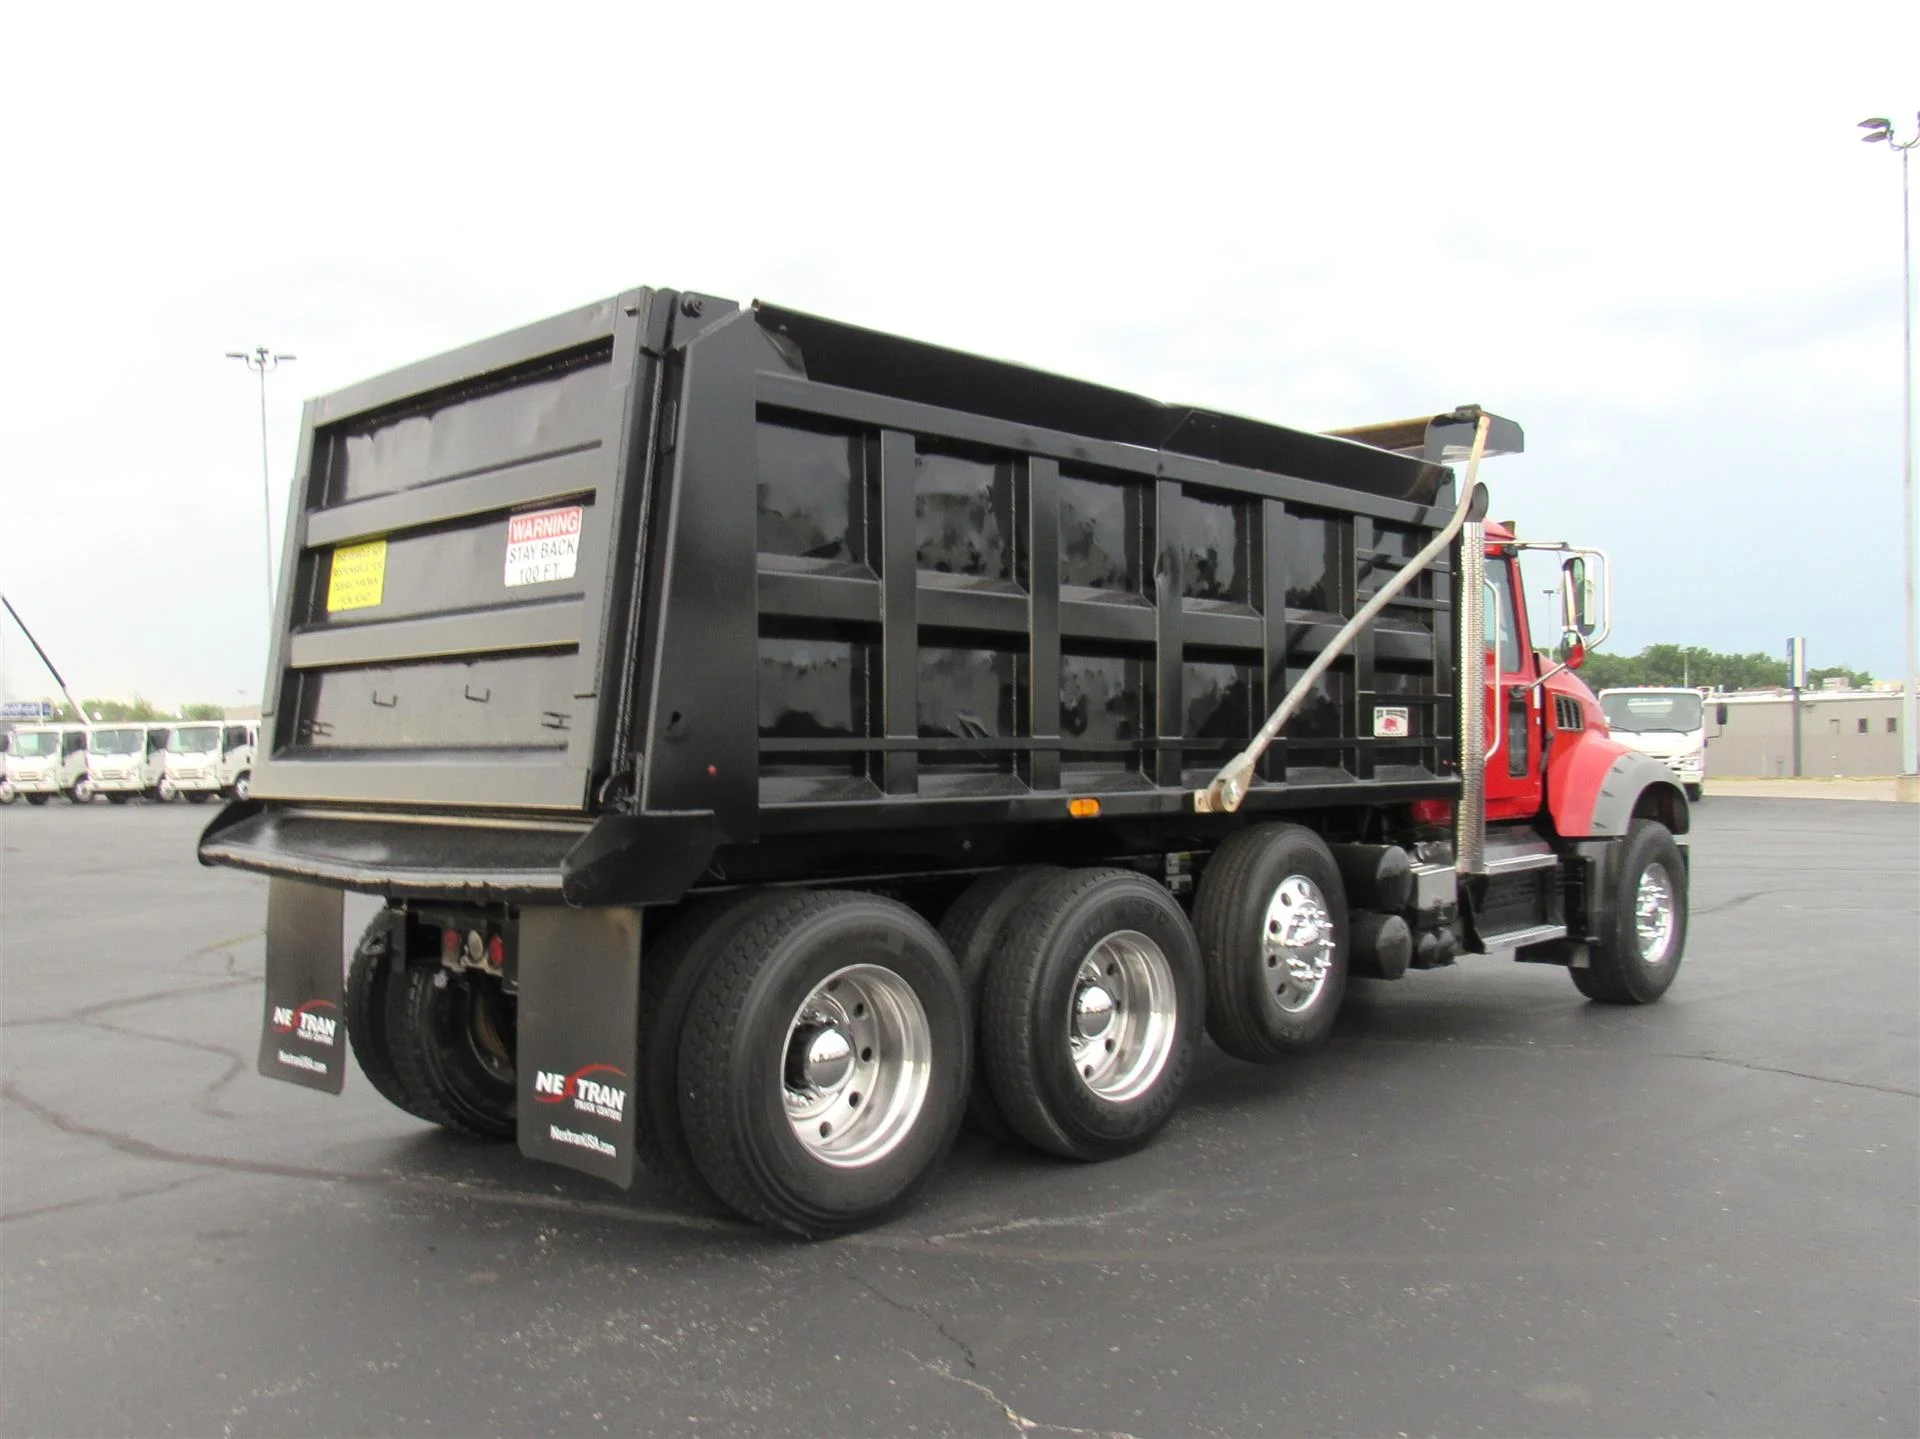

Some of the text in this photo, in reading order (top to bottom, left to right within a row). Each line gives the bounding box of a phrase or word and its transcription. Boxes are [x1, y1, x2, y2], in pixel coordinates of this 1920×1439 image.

[512, 511, 578, 542] WARNING
[509, 538, 575, 564] STAY BACK
[520, 565, 539, 584] 100
